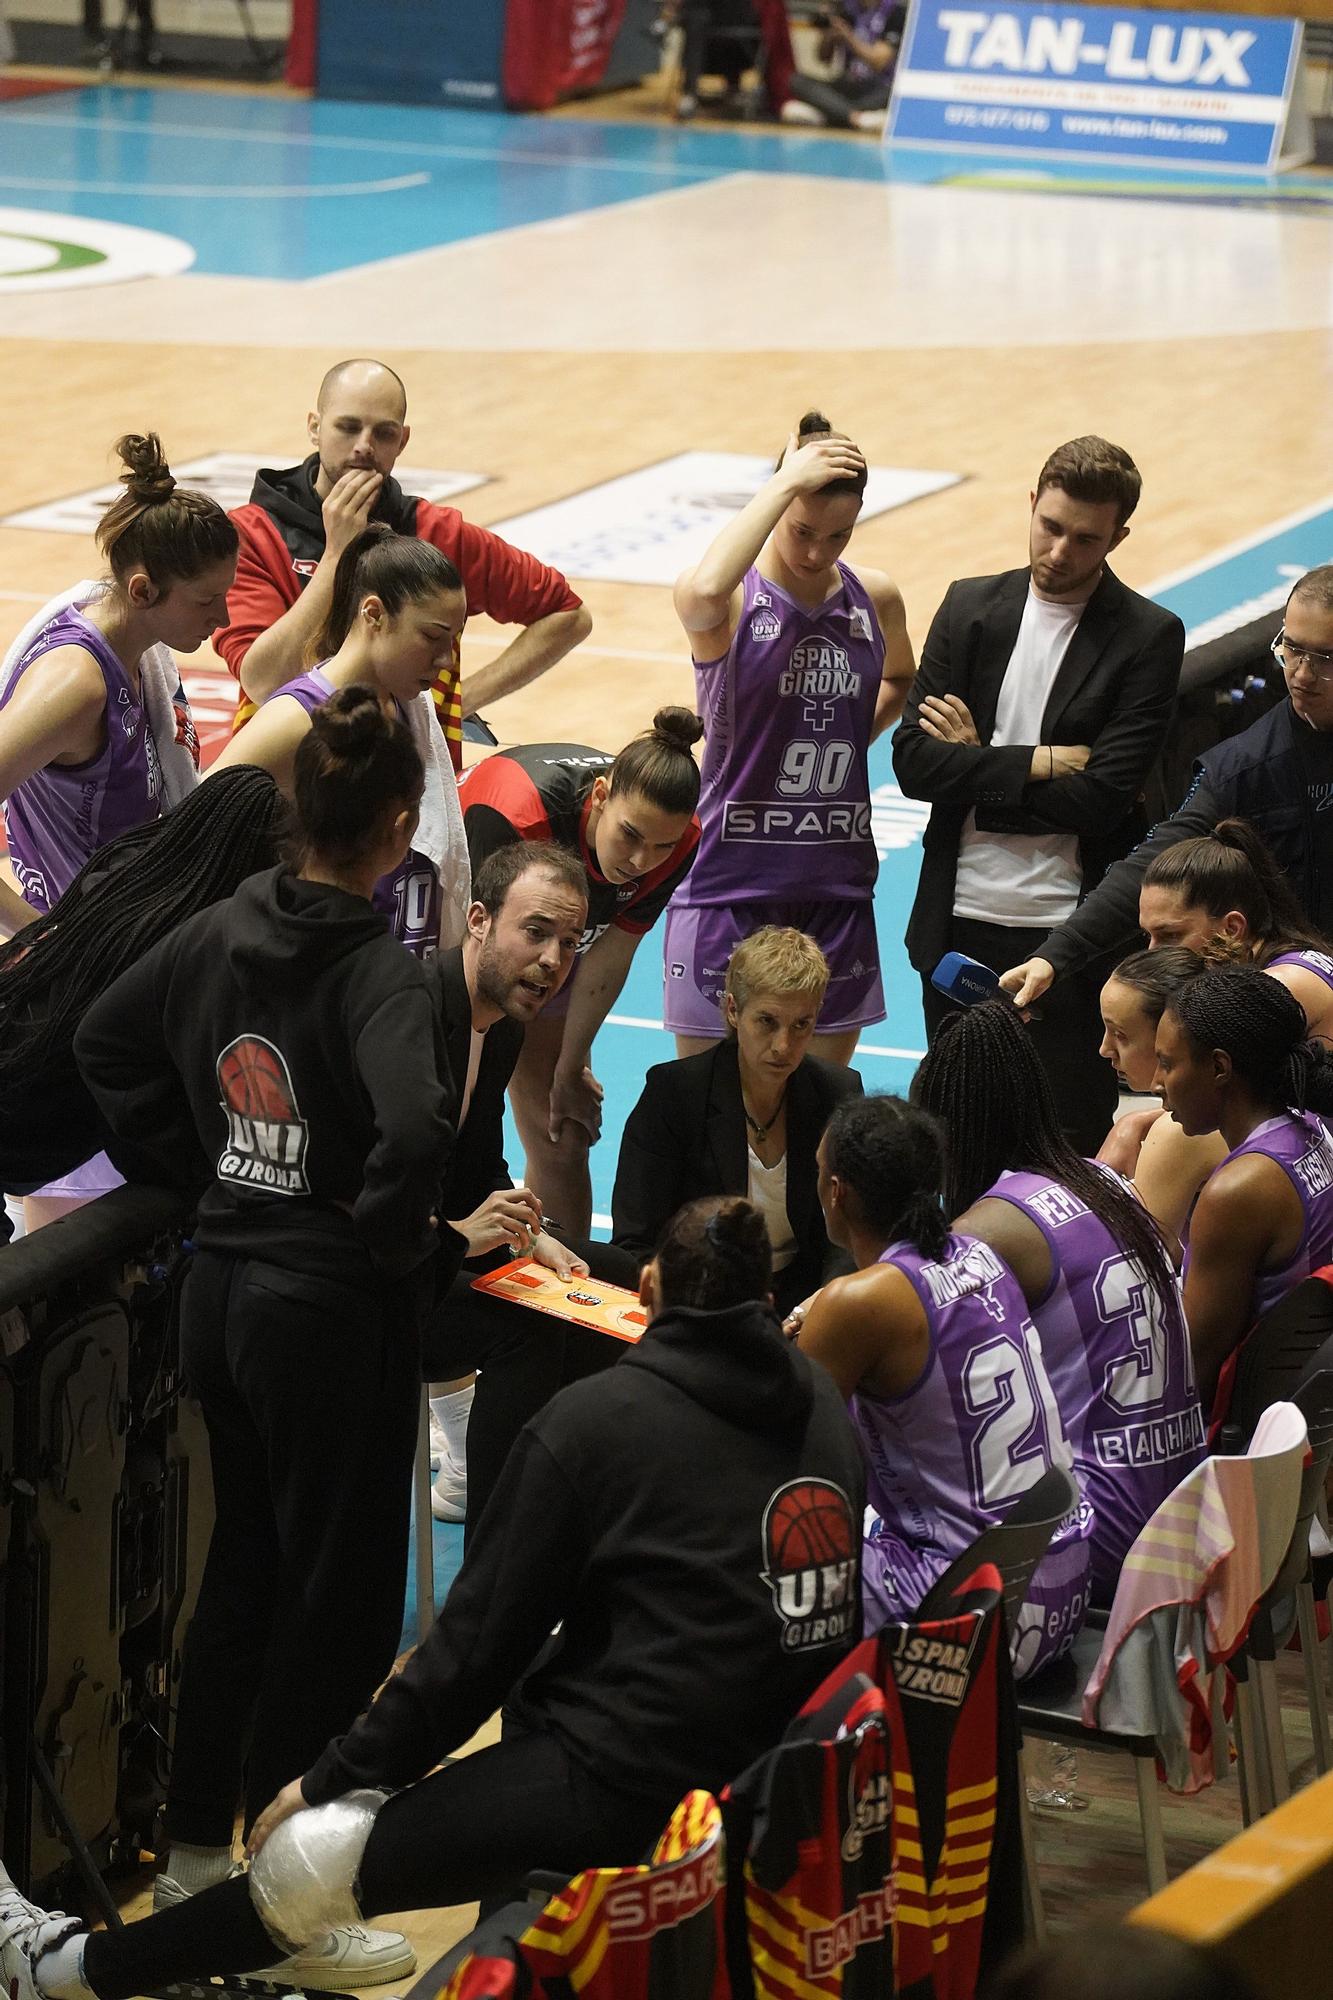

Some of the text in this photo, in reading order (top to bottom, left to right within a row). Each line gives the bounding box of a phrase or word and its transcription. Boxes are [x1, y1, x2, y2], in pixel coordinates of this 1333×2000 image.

[938, 11, 1257, 87] TAN-LUX
[793, 647, 847, 670] SPAR
[779, 671, 861, 698] GIRONA
[775, 739, 853, 797] 90
[727, 808, 851, 836] SPAR
[392, 868, 438, 936] 10
[232, 1113, 303, 1164] UNI
[220, 1154, 303, 1189] GIRONA
[961, 1317, 1074, 1512] 21
